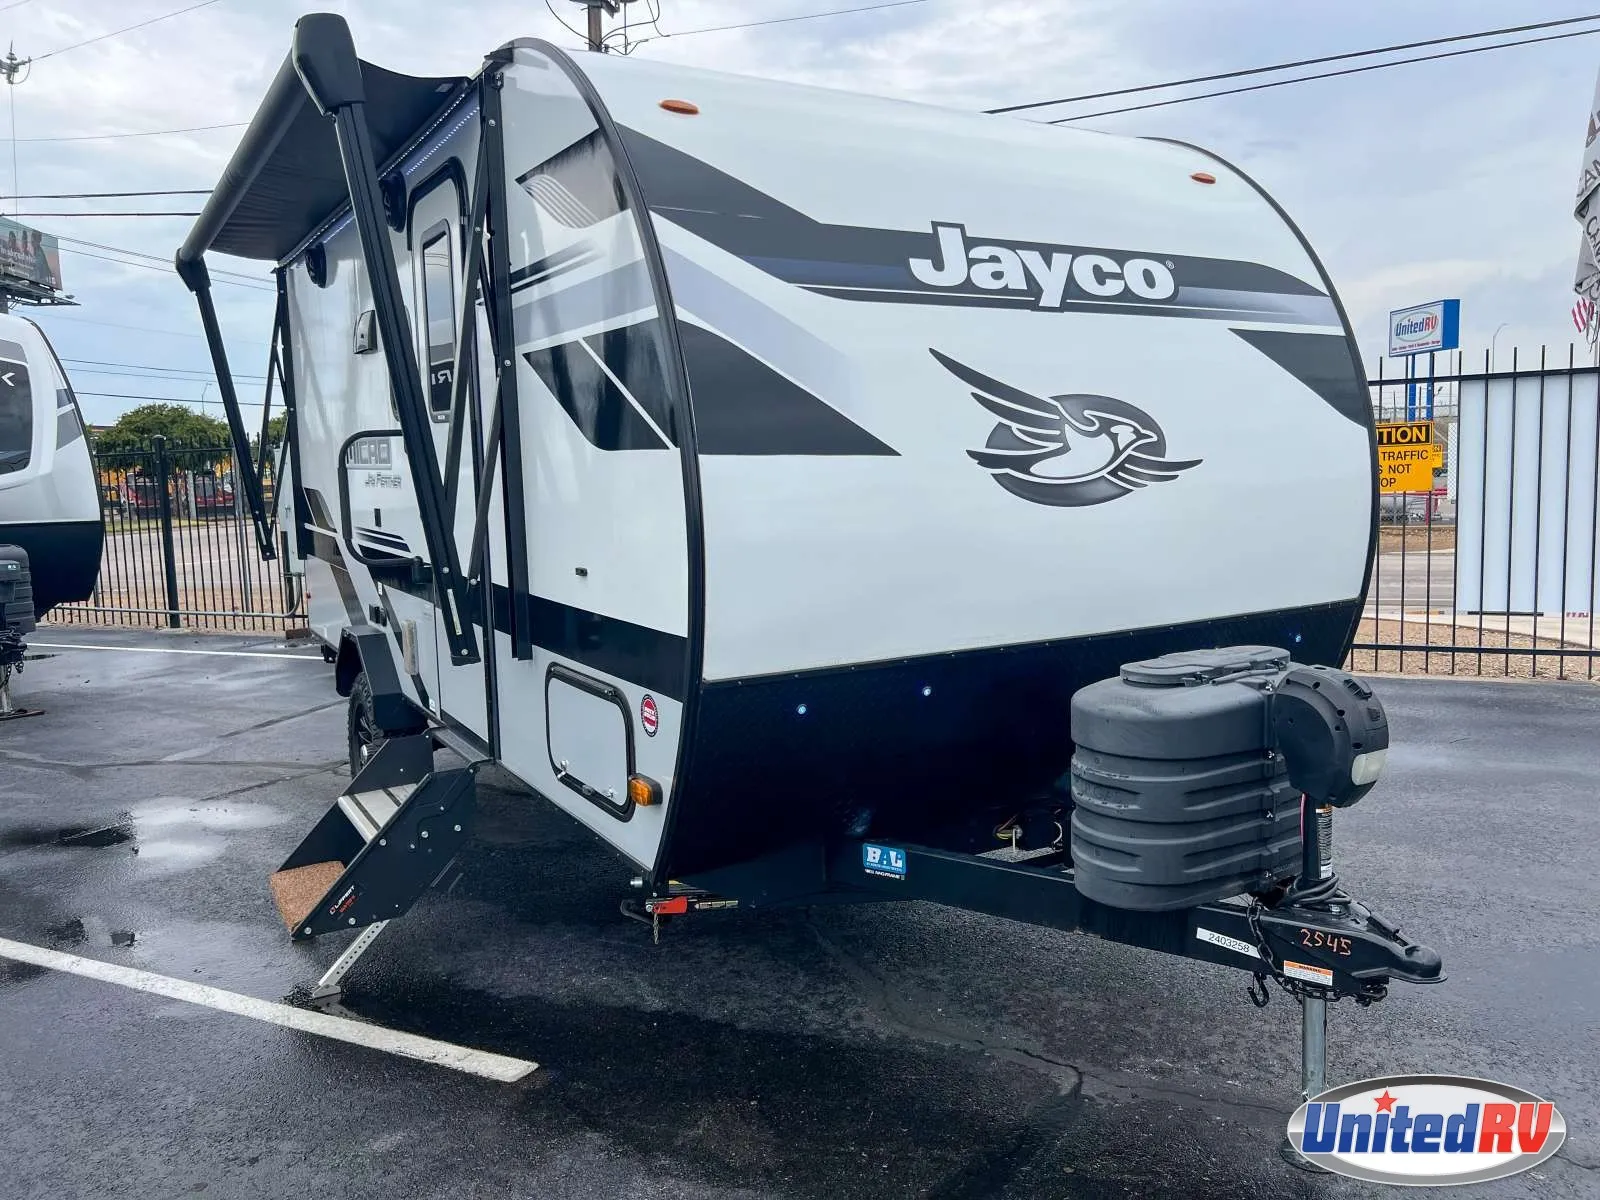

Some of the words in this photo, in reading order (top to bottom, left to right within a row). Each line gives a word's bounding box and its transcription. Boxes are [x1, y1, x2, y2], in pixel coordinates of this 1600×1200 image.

[908, 226, 1175, 307] Jayco
[1395, 315, 1437, 336] UnitedRV
[1377, 426, 1426, 444] TION
[1381, 450, 1429, 461] TRAFFIC
[1388, 463, 1412, 475] NOT
[1379, 477, 1397, 488] OP
[1208, 932, 1250, 953] 2403258
